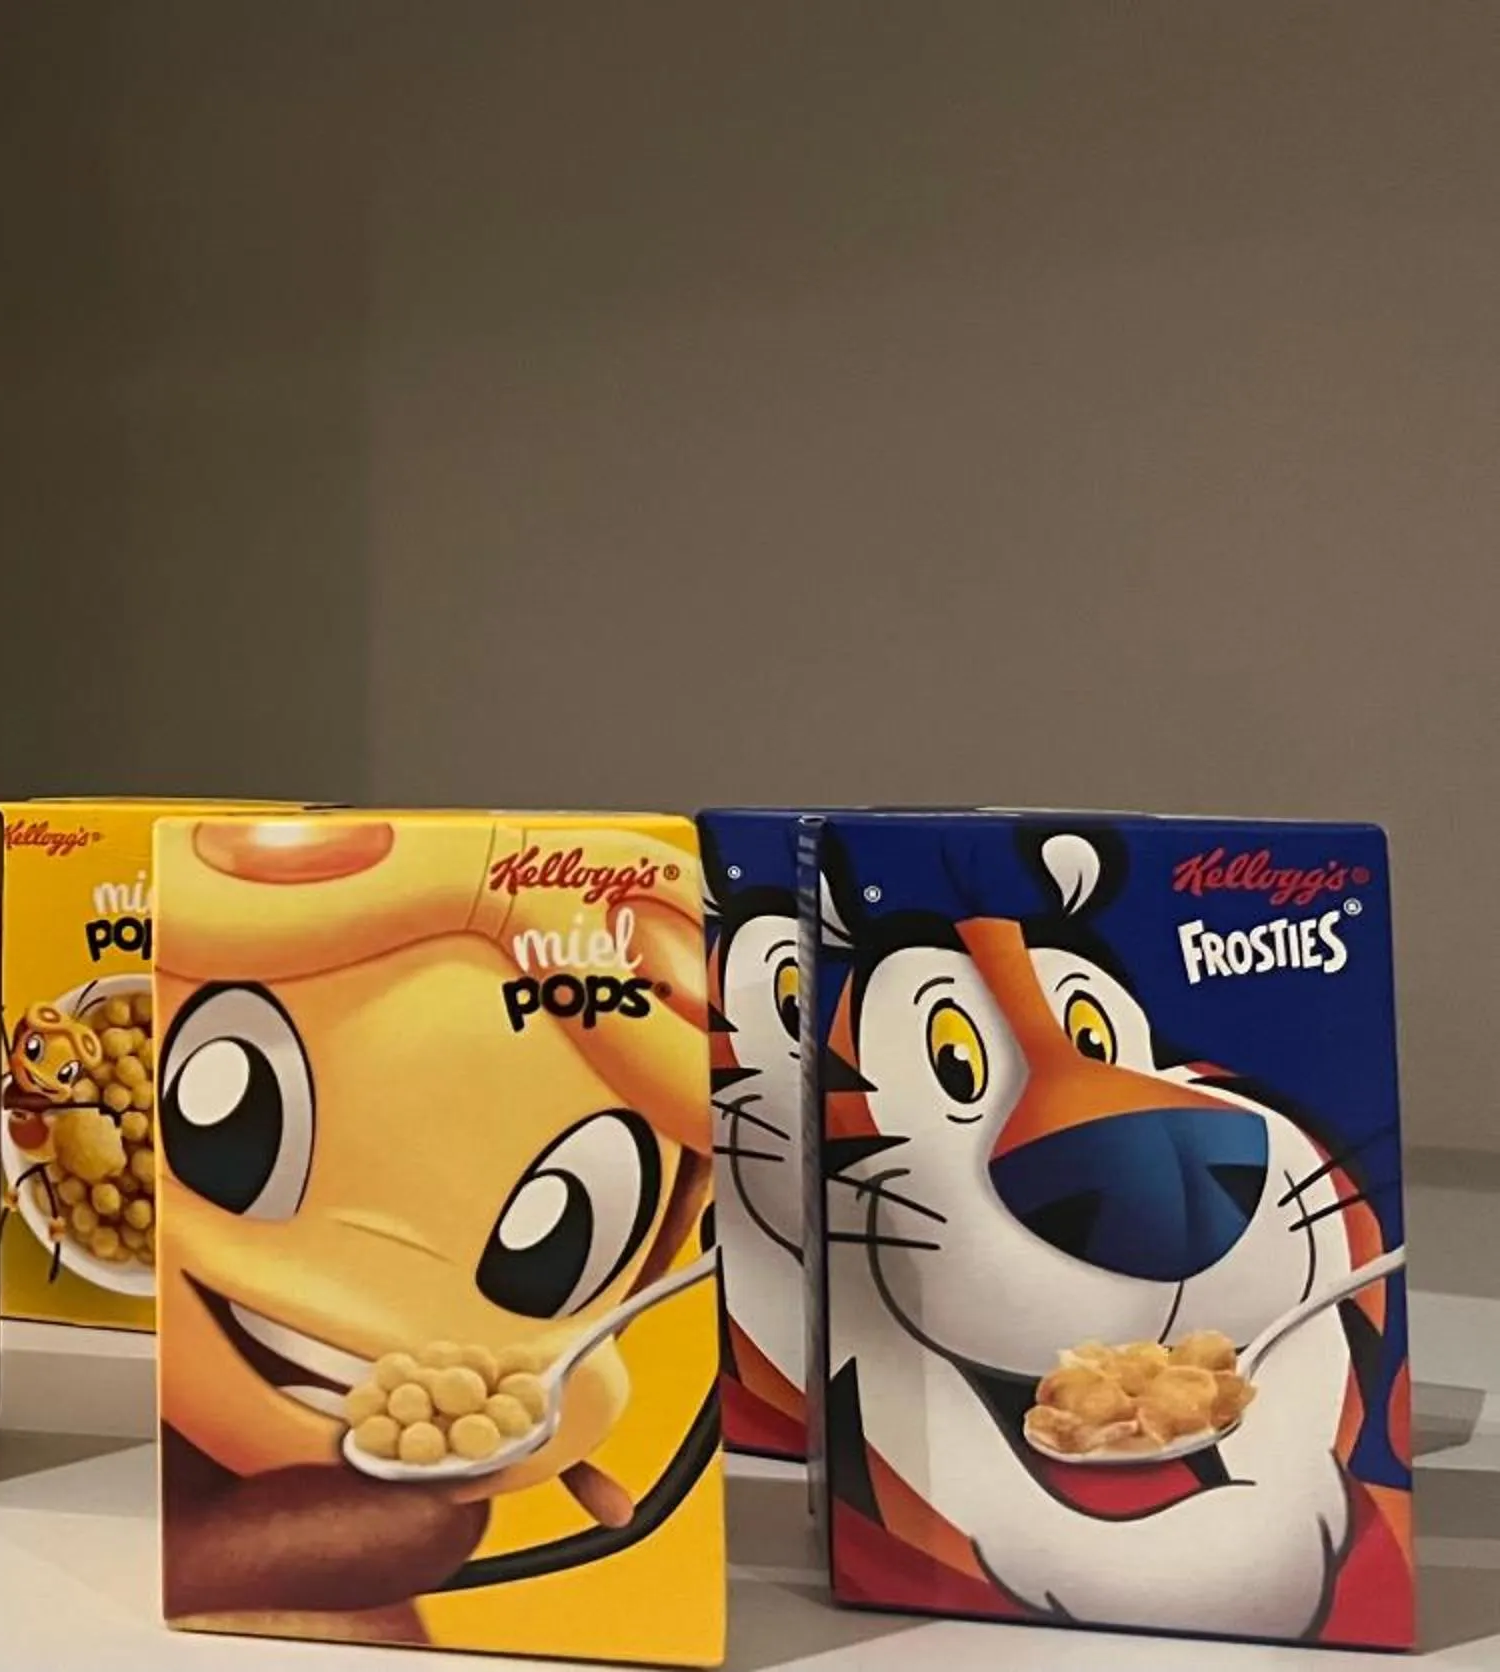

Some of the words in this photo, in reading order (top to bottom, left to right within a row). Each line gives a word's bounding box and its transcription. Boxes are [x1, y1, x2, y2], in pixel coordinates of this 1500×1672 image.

[488, 845, 659, 905] Kellogg's
[1172, 847, 1349, 907] Kellogg's
[513, 906, 644, 973] miel
[1177, 909, 1349, 986] FROSTIES
[501, 973, 653, 1033] pops
